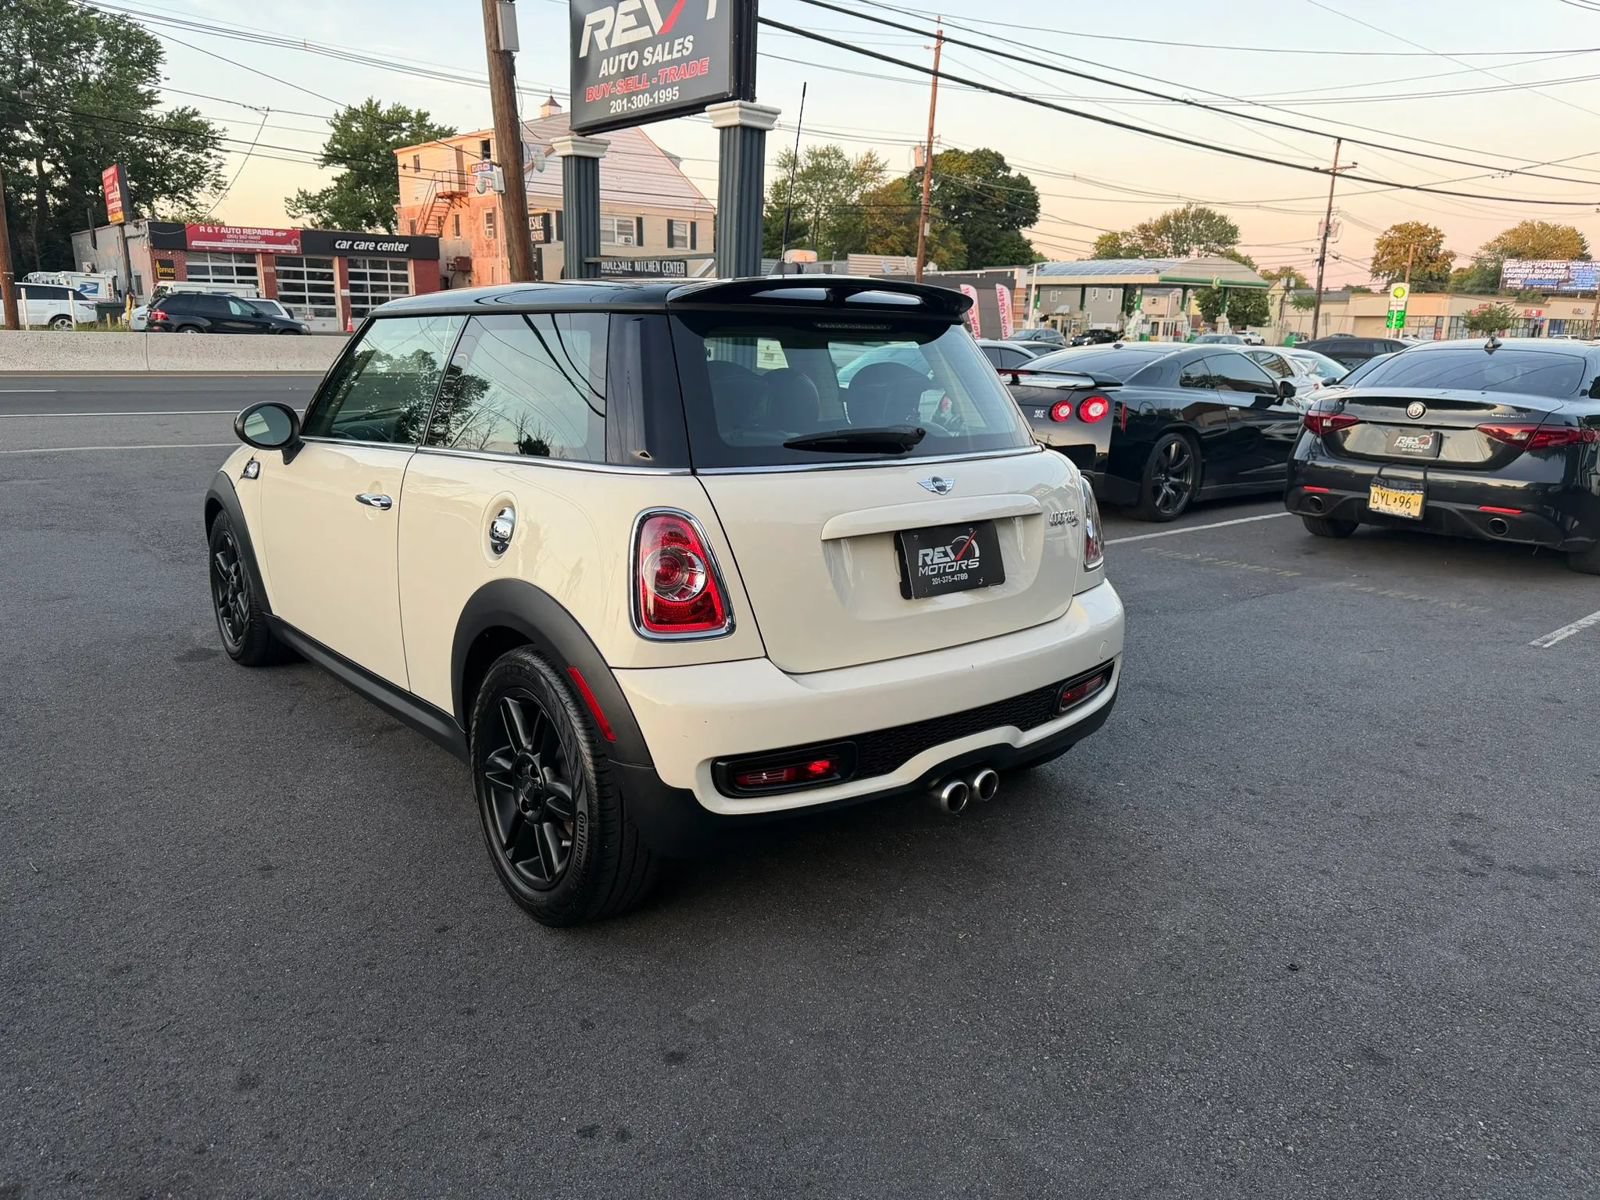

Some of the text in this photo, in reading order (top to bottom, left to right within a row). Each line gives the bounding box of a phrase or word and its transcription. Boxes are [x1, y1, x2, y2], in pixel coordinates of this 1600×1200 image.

[598, 35, 694, 79] AUTO SALES
[609, 86, 680, 114] 201-300-1995
[220, 227, 241, 235] AUTO
[243, 229, 274, 237] REPAIRS
[334, 239, 409, 252] car care center
[601, 260, 685, 274] HOLESALE KITCHEN CENTER
[1535, 261, 1567, 269] POUND
[918, 540, 966, 567] REV
[918, 558, 980, 577] MOTORS
[931, 572, 969, 585] 201-375-4789
